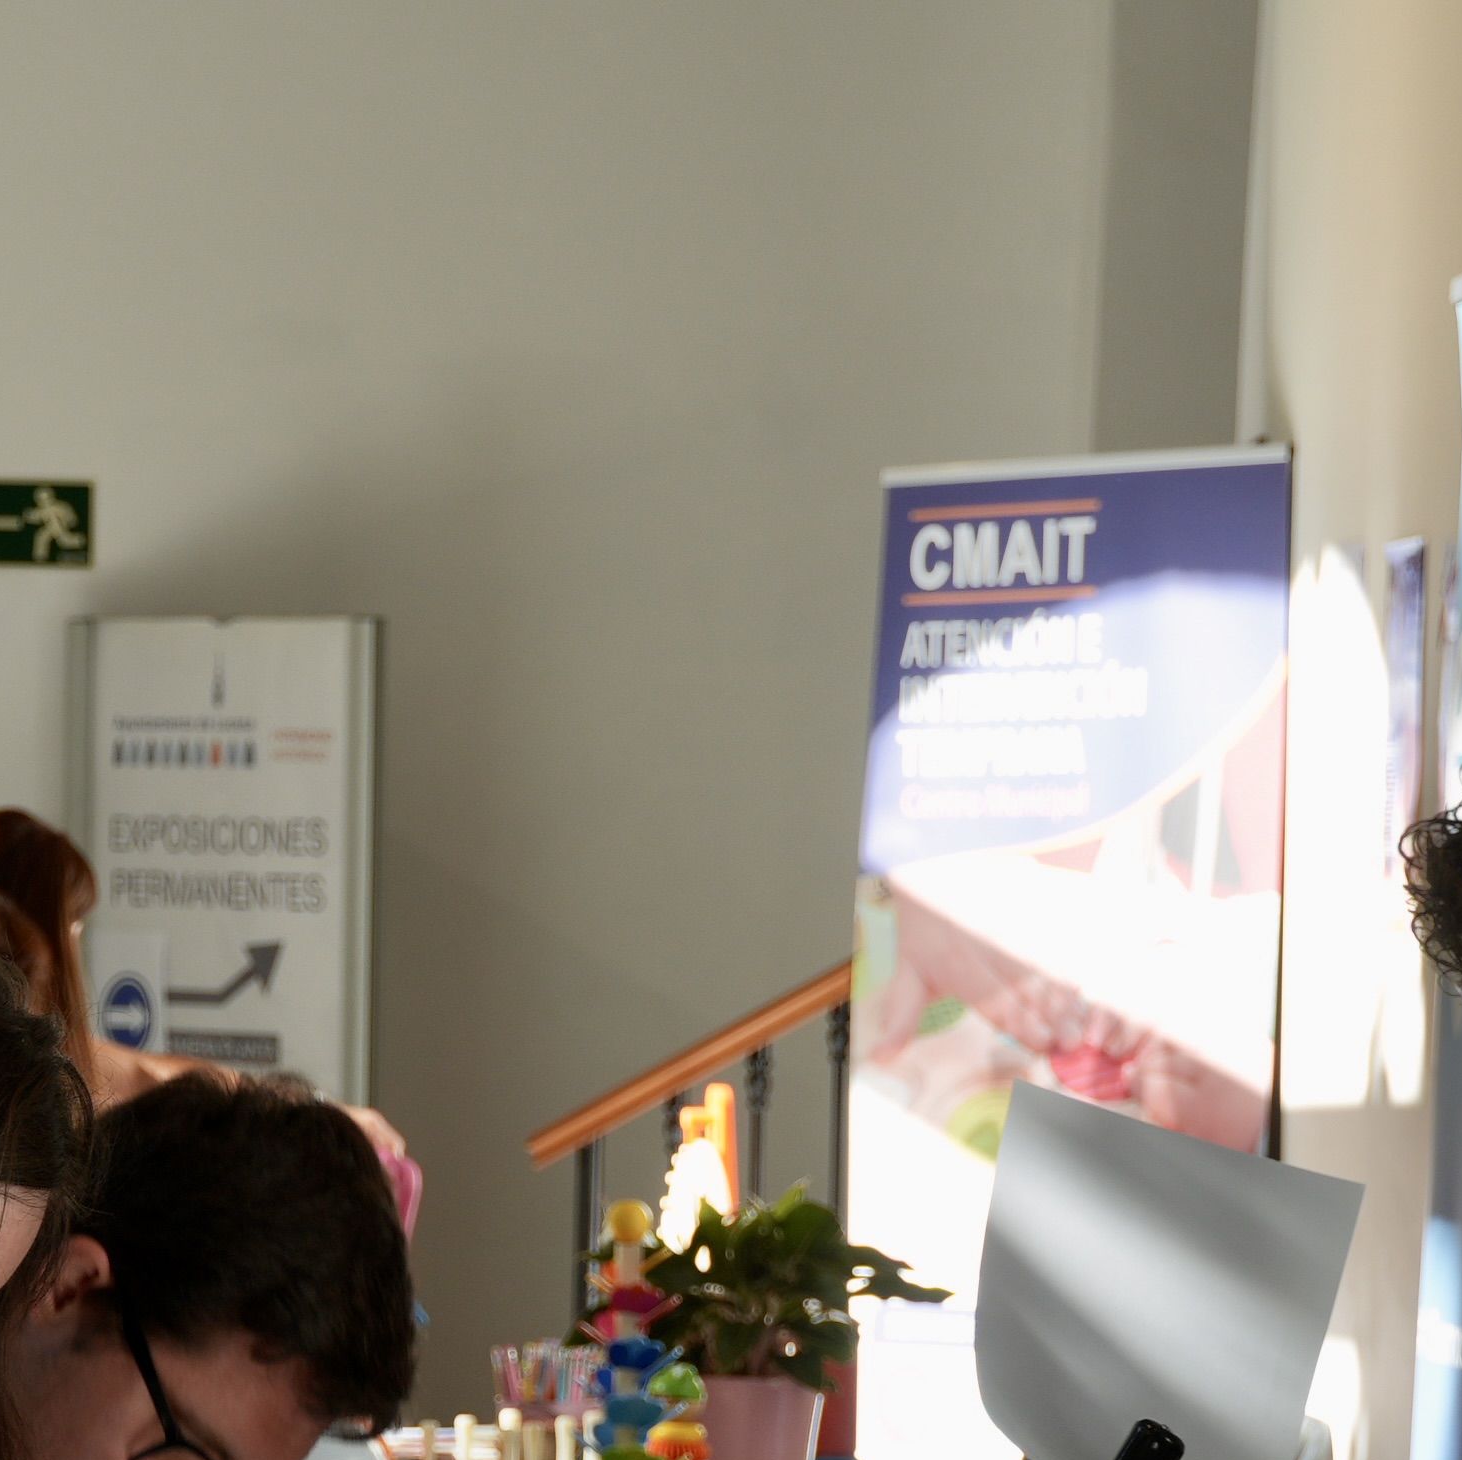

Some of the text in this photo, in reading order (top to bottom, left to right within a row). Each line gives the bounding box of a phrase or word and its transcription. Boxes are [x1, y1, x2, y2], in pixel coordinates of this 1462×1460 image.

[909, 515, 1097, 591] CMAIT
[108, 813, 329, 857] EXPOSICIONES
[110, 868, 327, 913] PERMANENTES
